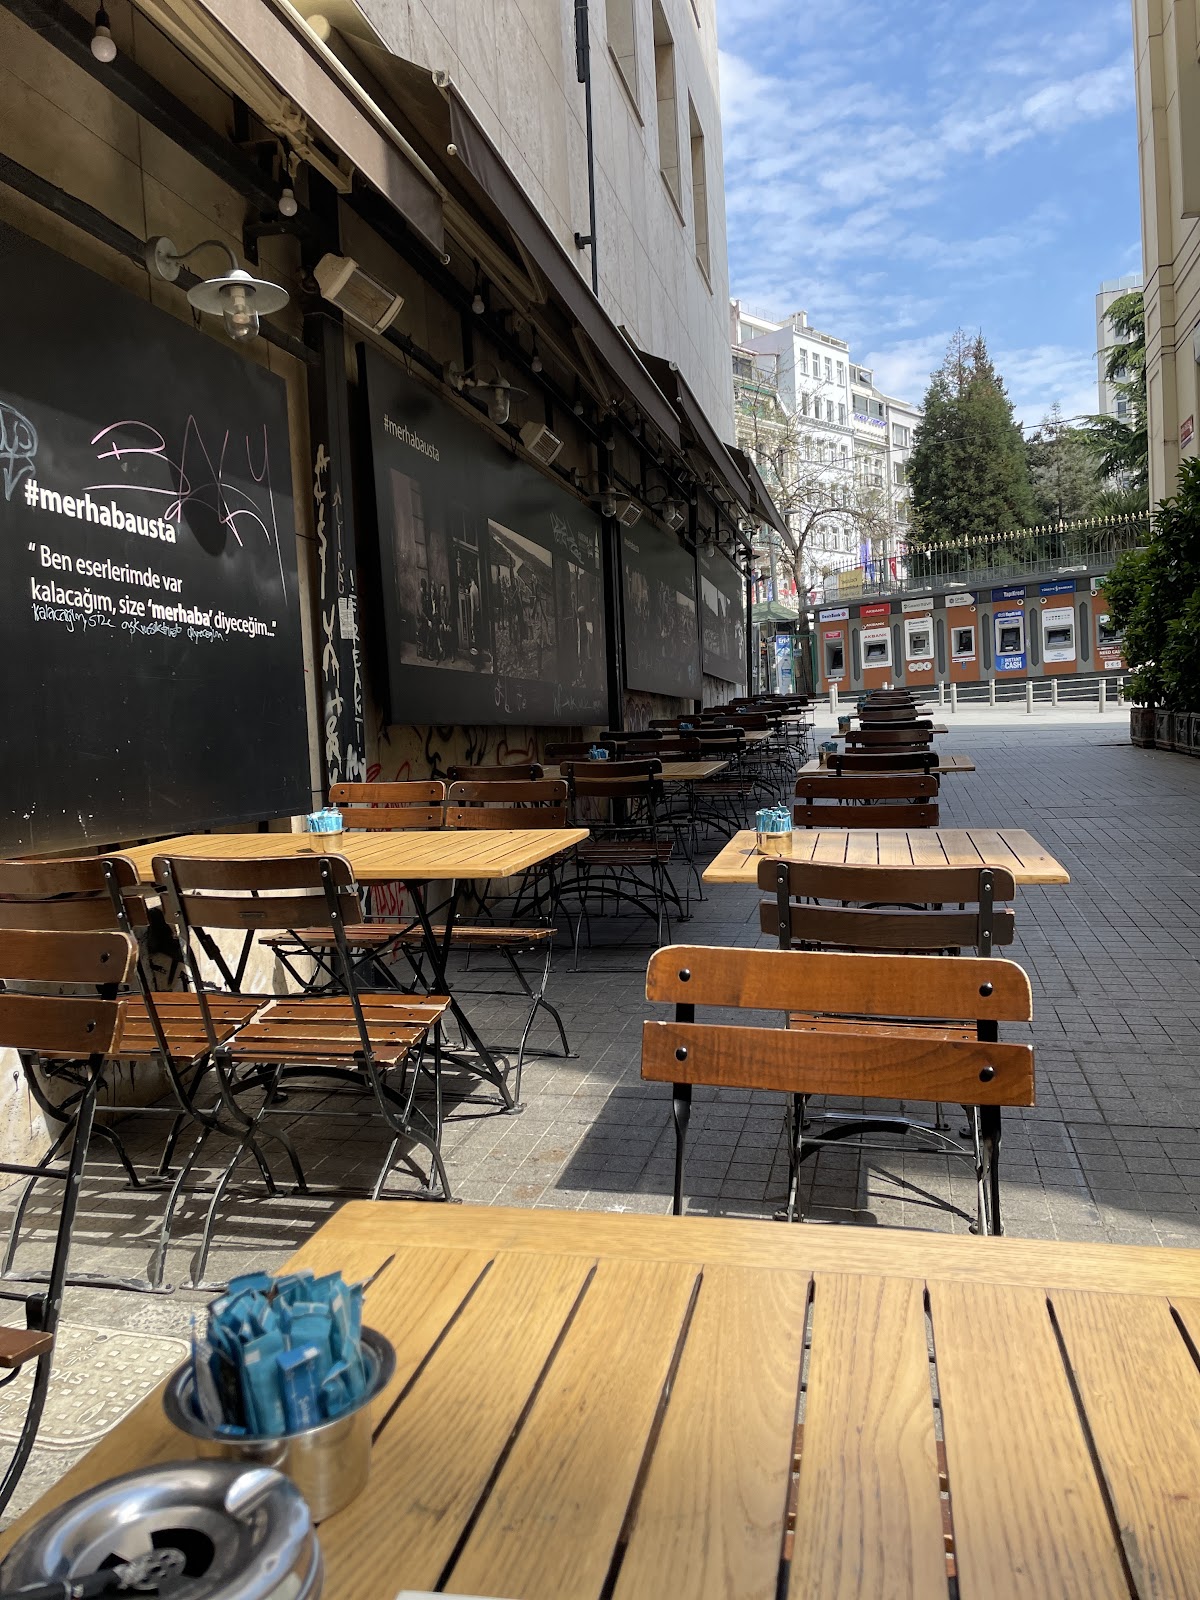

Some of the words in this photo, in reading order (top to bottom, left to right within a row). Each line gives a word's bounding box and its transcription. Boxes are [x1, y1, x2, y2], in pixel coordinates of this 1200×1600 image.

[383, 413, 440, 462] #merhabausta
[24, 478, 177, 544] #merhabausta
[40, 544, 73, 572] Ben
[75, 558, 160, 589] eserlerimde
[161, 575, 183, 593] var
[30, 577, 117, 615] kalacağım,
[119, 595, 146, 617] size
[1004, 661, 1022, 670] CASH
